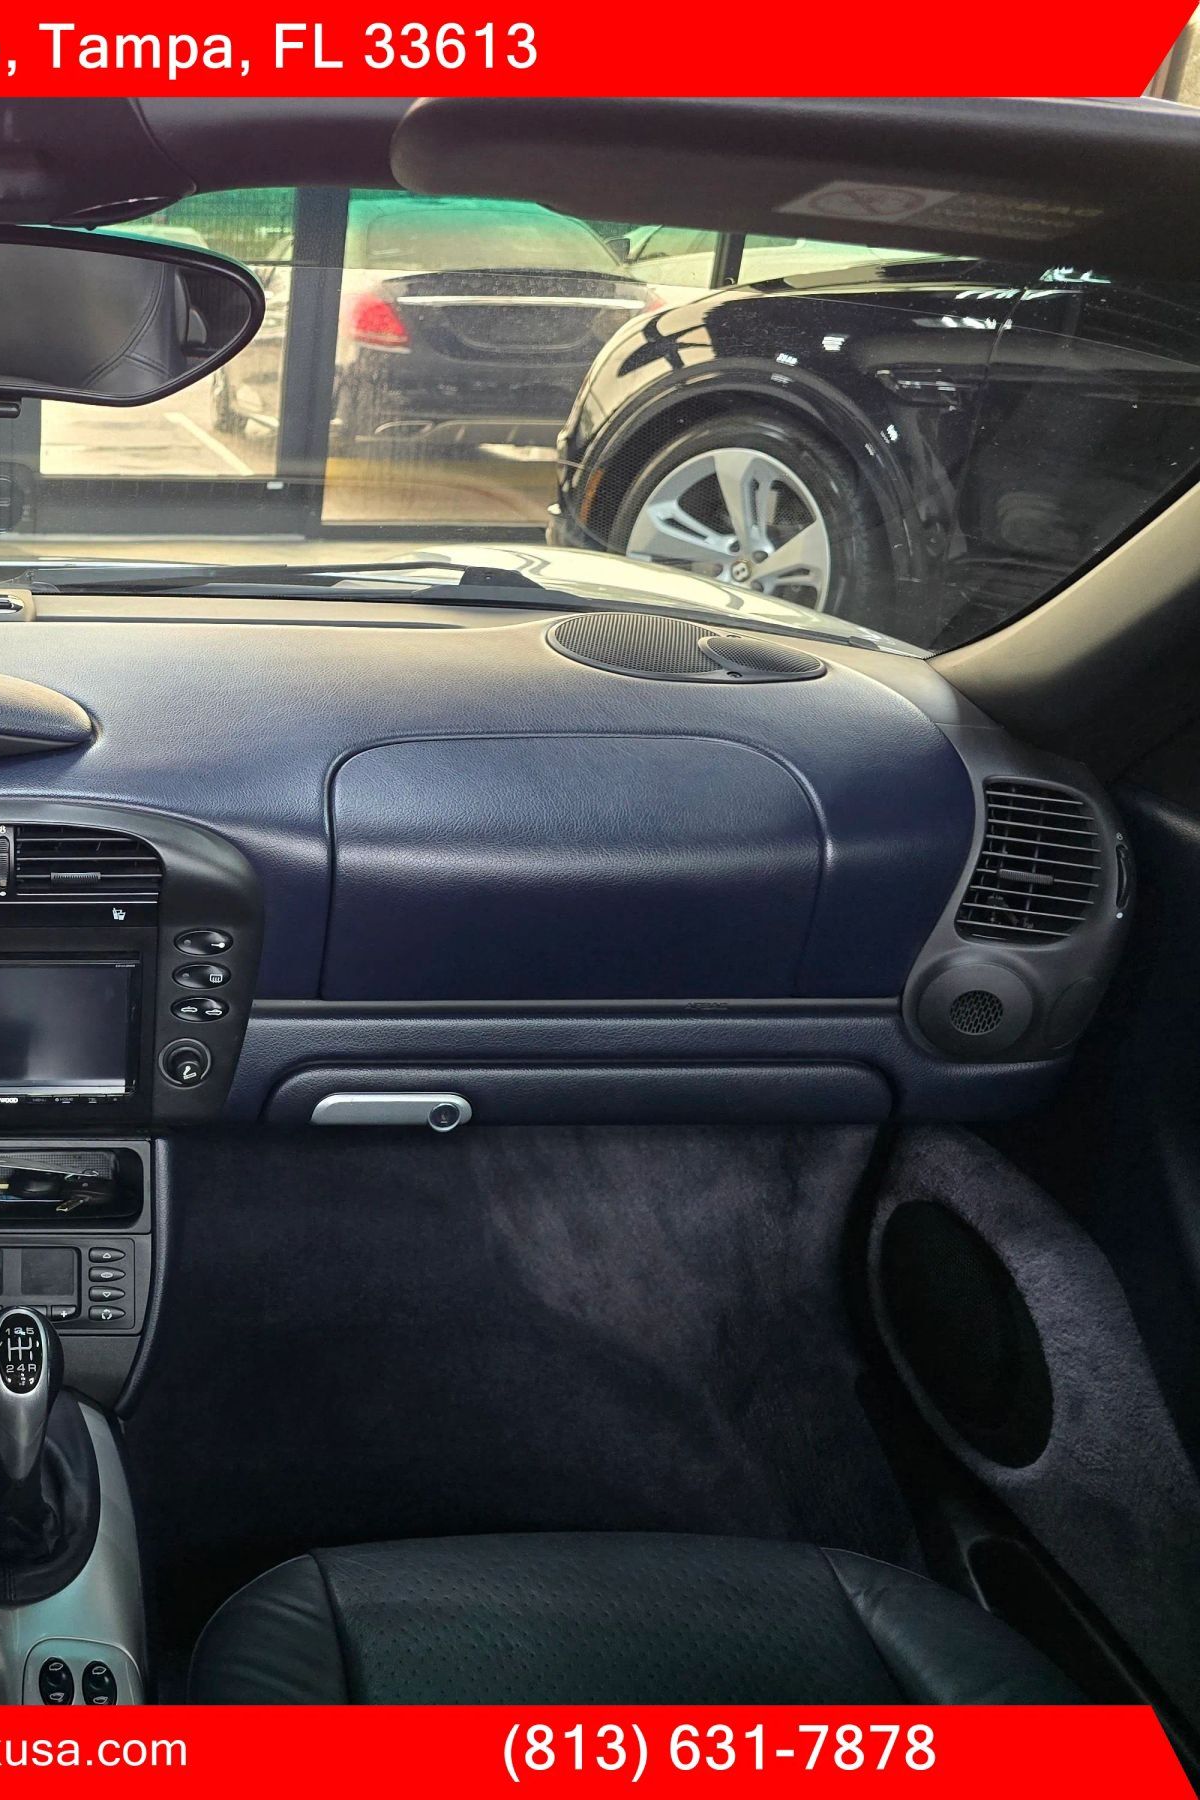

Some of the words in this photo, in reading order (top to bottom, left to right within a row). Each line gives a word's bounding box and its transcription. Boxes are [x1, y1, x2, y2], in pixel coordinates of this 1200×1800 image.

[5, 1328, 11, 1336] 1
[25, 1327, 35, 1335] 5
[6, 1364, 15, 1373] 2
[16, 1363, 26, 1372] 4
[27, 1363, 37, 1372] R
